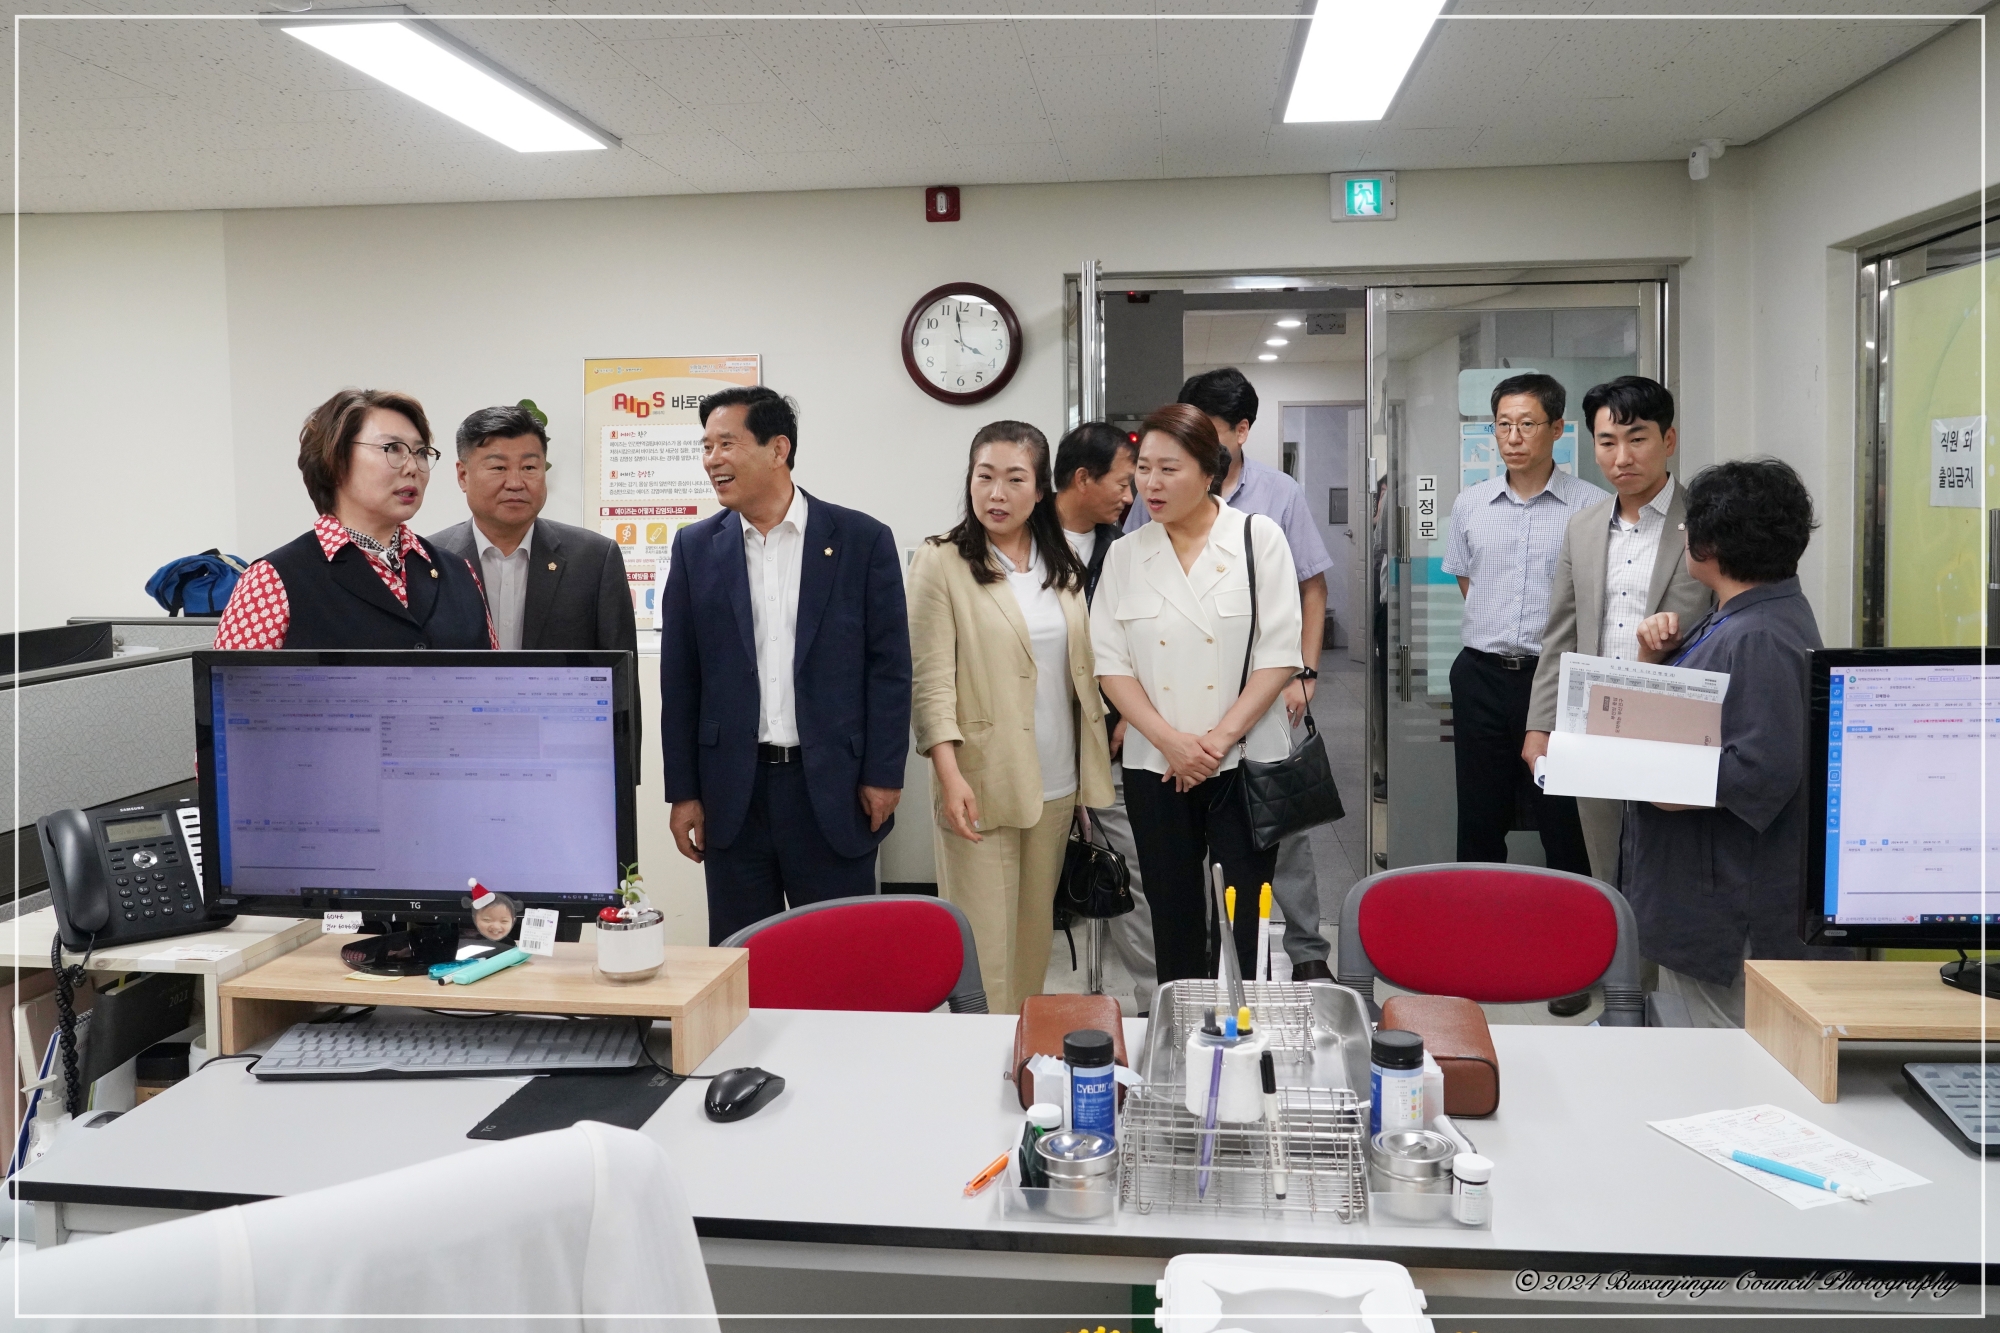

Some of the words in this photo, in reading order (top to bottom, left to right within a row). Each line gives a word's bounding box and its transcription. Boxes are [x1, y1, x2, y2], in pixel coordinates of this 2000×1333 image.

[941, 305, 950, 316] 11
[959, 301, 970, 312] 12
[979, 306, 984, 317] 1
[926, 318, 938, 329] 10
[991, 320, 998, 331] 2
[921, 338, 930, 349] 9
[995, 339, 1003, 350] 3
[926, 356, 935, 367] 8
[988, 358, 996, 368] 4
[940, 371, 947, 382] 7
[956, 375, 965, 386] 6
[975, 372, 983, 383] 5
[614, 391, 665, 418] AIDS
[1941, 430, 1959, 452] 직원
[1963, 429, 1973, 452] 외
[1939, 466, 1974, 489] 출입금지
[1419, 478, 1435, 536] 고정문
